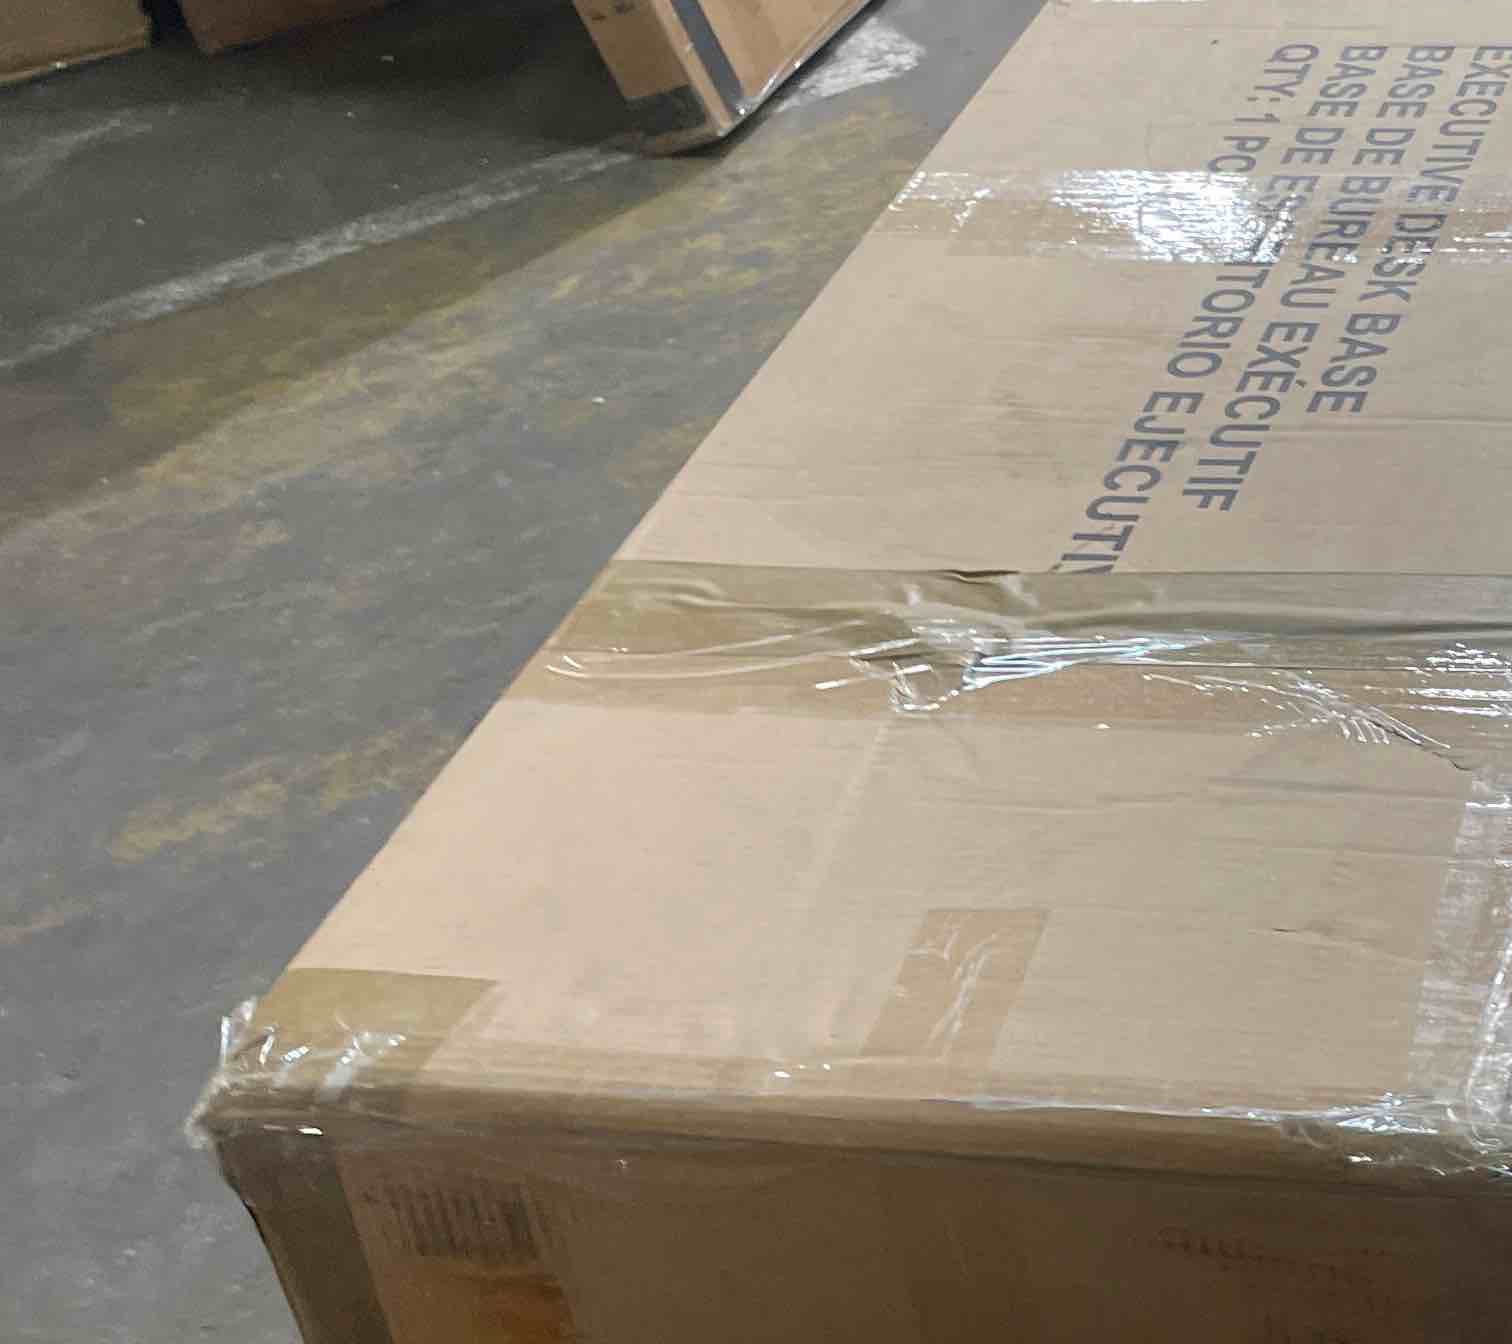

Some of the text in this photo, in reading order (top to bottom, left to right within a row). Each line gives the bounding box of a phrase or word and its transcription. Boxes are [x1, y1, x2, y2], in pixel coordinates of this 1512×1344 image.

[1206, 43, 1321, 179] QTY: 1 PC
[1305, 45, 1389, 120] BASE
[1278, 127, 1345, 166] DE
[1165, 174, 1321, 379] ESITORIO
[1181, 45, 1456, 513] BASE DE BUREAU EXÉCUTIF
[1356, 212, 1450, 304] DESK
[1305, 312, 1401, 415] BASE
